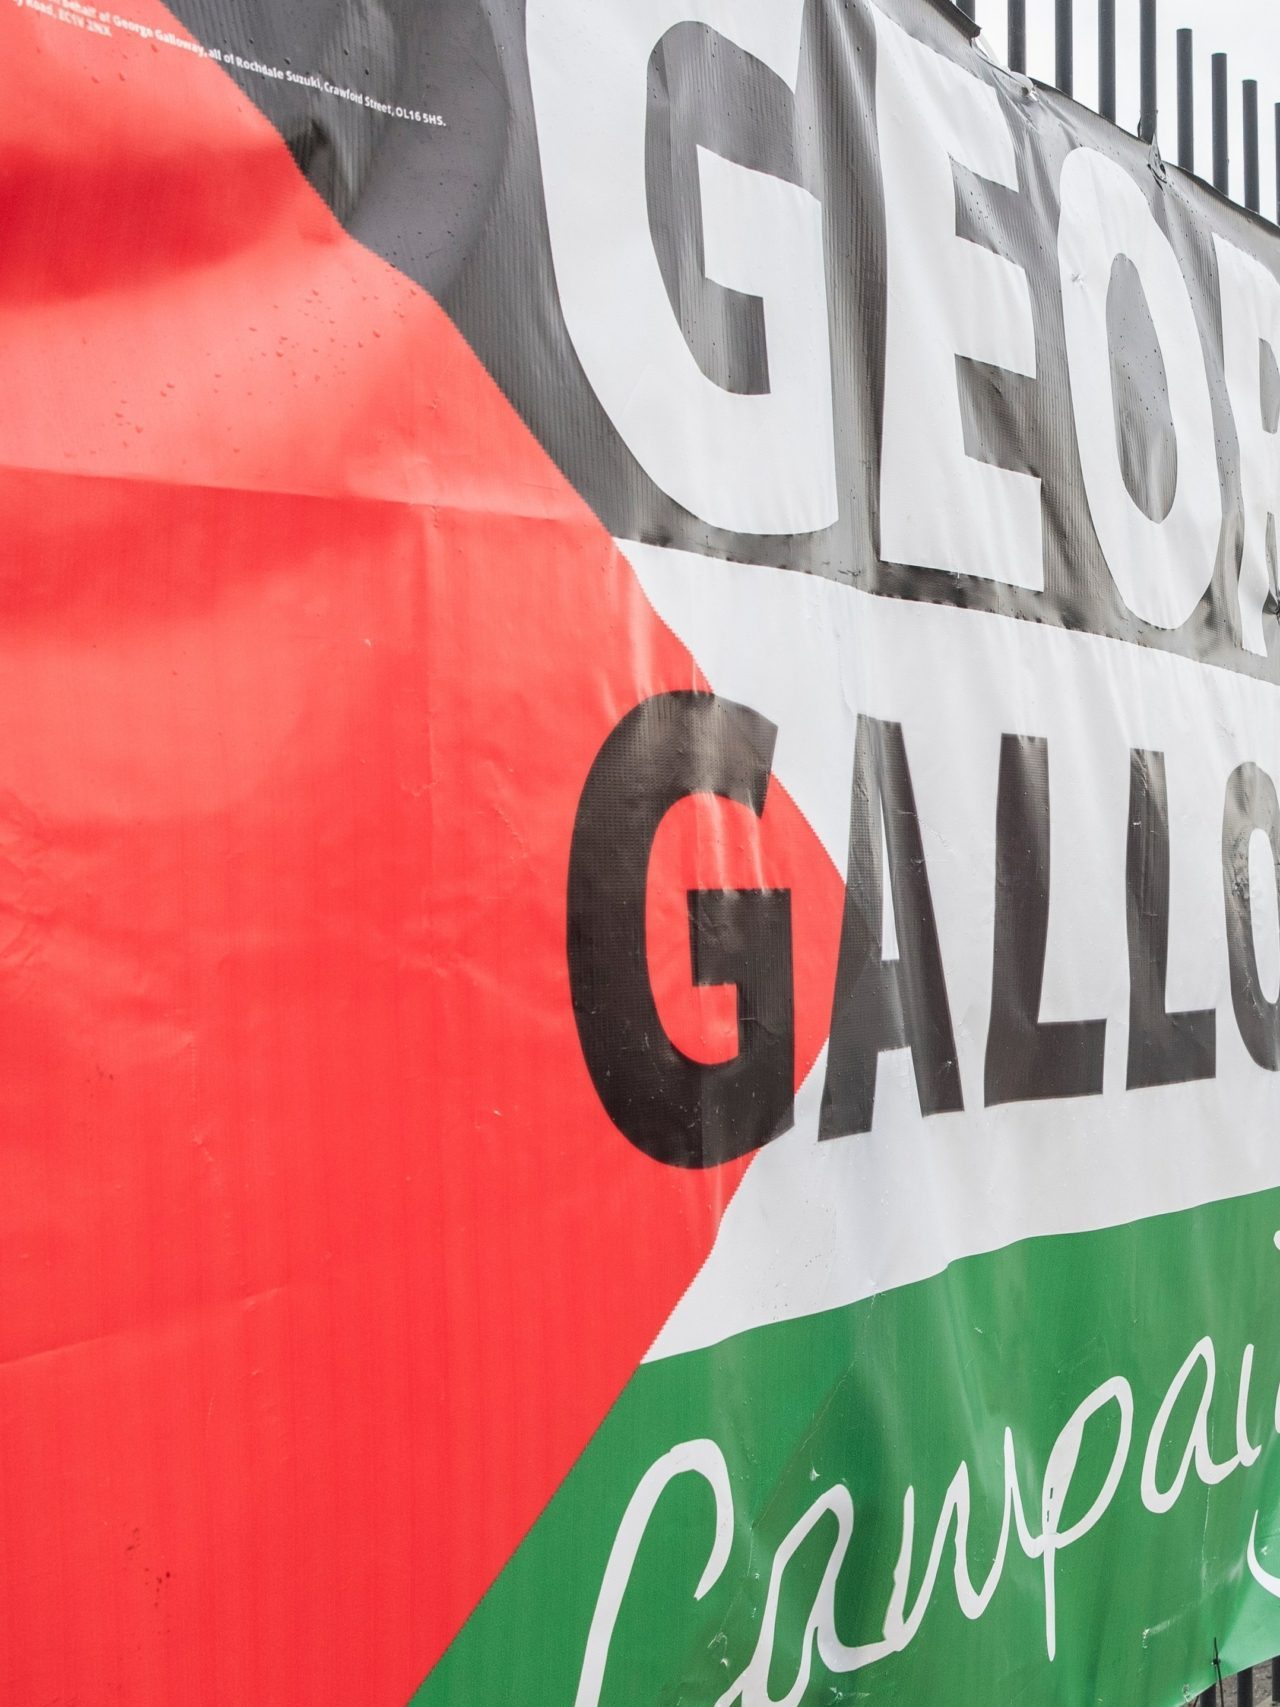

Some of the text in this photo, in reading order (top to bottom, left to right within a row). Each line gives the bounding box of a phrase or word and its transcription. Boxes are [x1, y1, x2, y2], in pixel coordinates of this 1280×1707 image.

[112, 14, 152, 38] George
[154, 28, 207, 57] Galloway,
[208, 48, 222, 61] all
[224, 51, 235, 65] of
[235, 56, 284, 80] Rochdale
[286, 69, 323, 91] Suzuki,
[323, 81, 363, 105] Crawford
[364, 95, 394, 117] Street,
[395, 107, 421, 123] OL16
[422, 113, 447, 127] 5HS.
